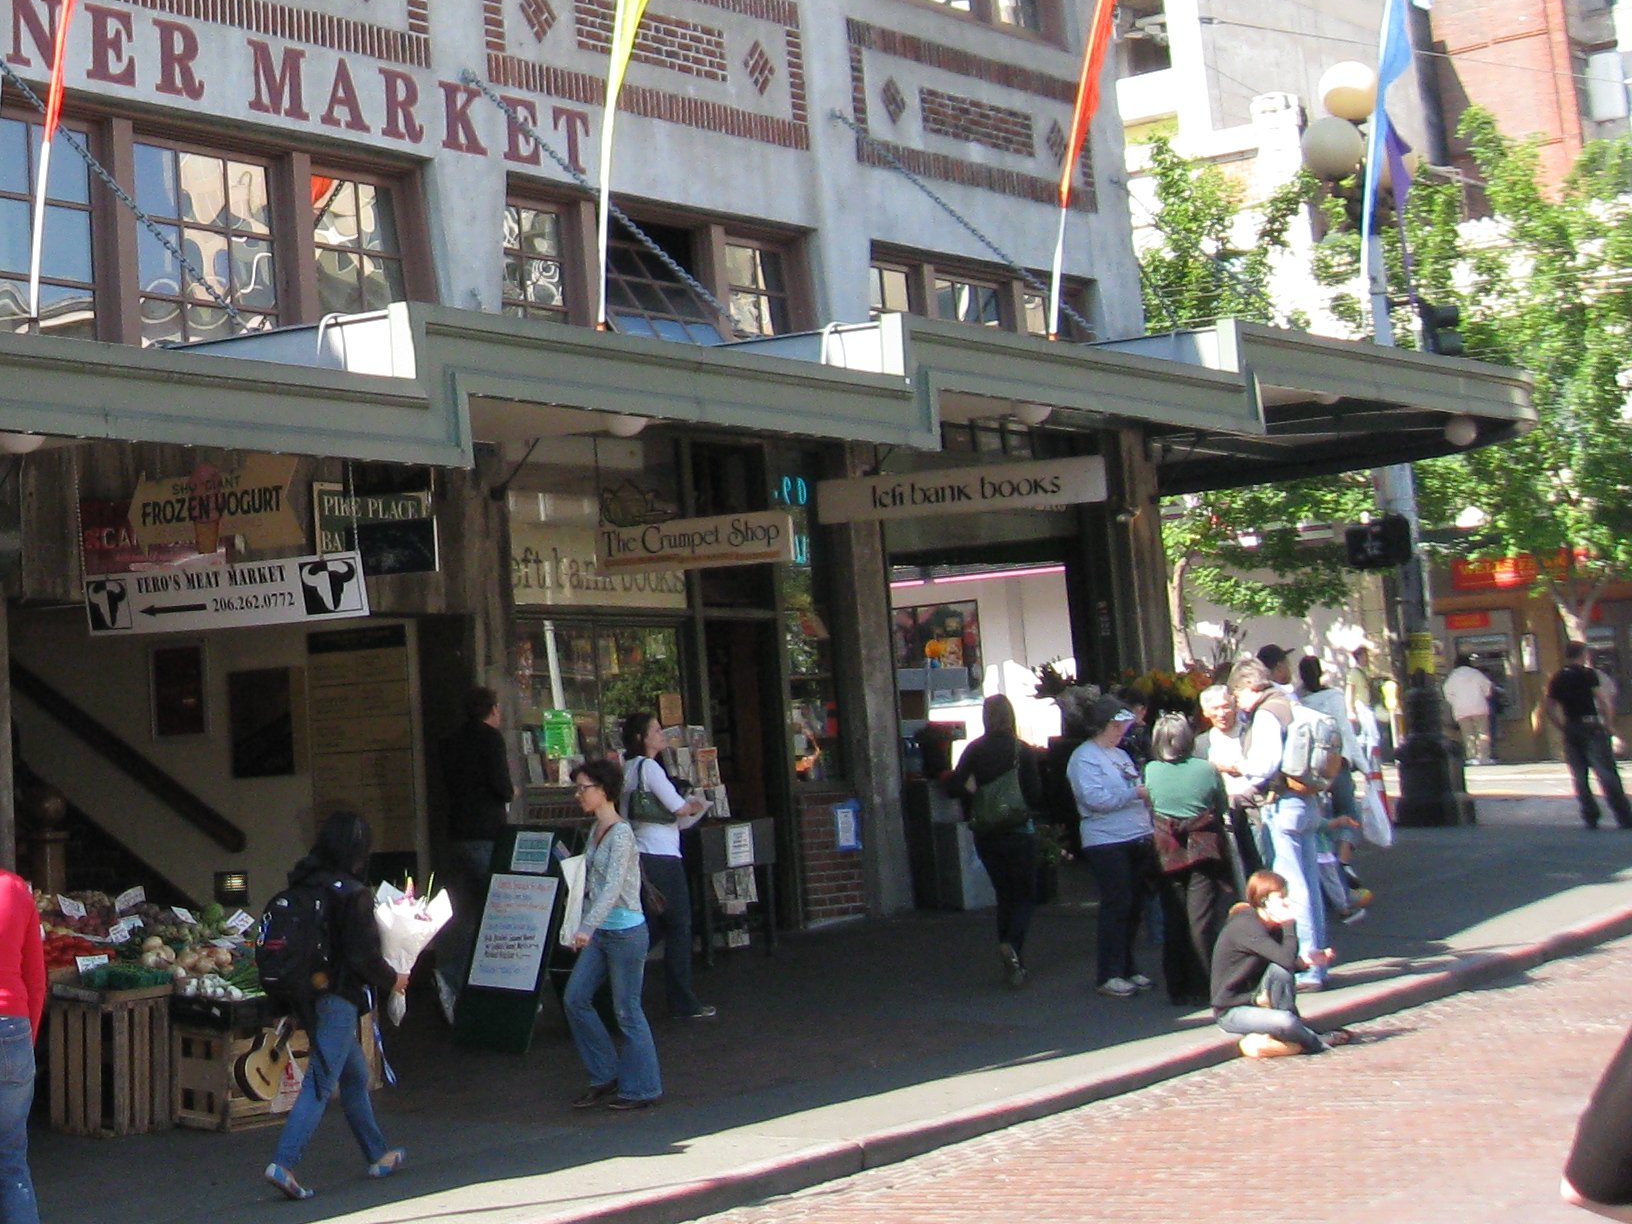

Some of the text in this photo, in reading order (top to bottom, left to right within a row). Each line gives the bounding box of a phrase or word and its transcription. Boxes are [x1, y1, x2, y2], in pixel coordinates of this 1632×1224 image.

[246, 36, 591, 175] MARKET
[141, 484, 283, 527] FROZEN YOGURT
[911, 482, 973, 506] bank
[980, 476, 1062, 500] books
[323, 494, 418, 520] PIKE PLACE
[322, 530, 346, 551] BA
[603, 519, 780, 558] The Crumpet Shop
[136, 565, 286, 594] FERO'S MEAT MARKET
[212, 591, 295, 613] 206.262.0772
